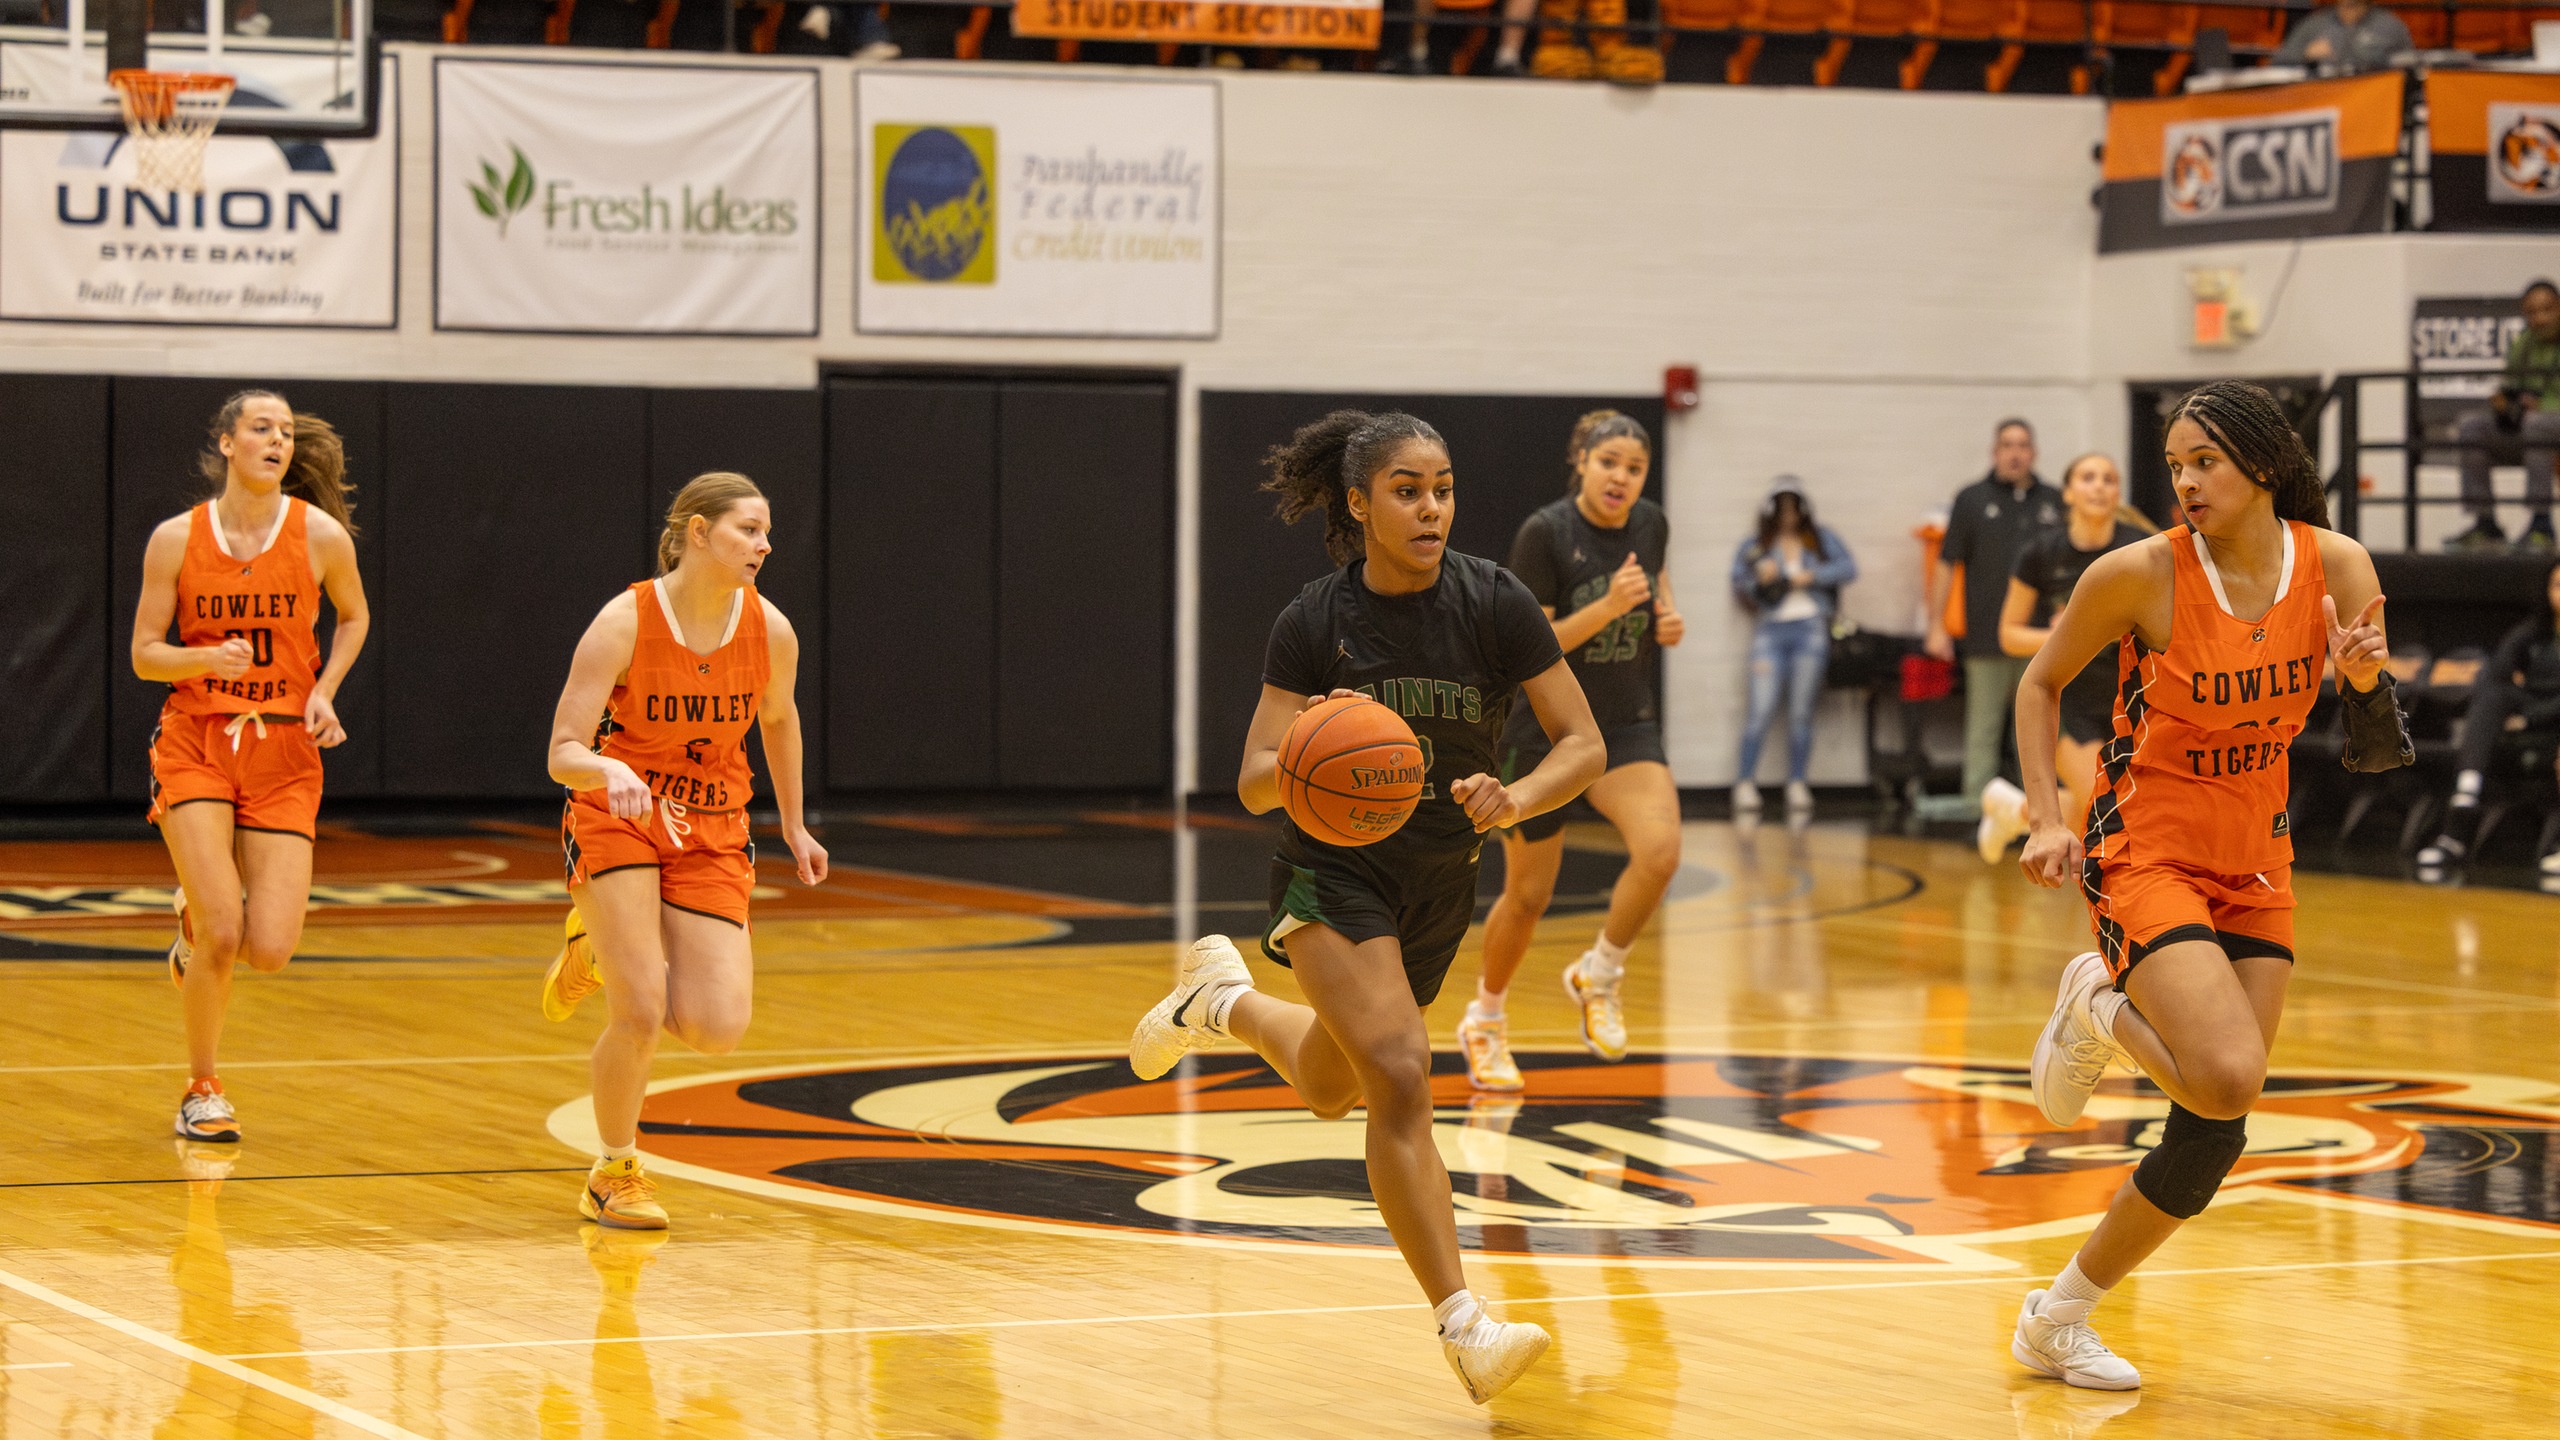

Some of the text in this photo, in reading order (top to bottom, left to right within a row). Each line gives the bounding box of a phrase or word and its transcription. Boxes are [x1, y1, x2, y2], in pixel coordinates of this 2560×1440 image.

[1047, 0, 1367, 36] STUDENT SECTION
[2226, 126, 2328, 199] CSN
[56, 183, 342, 233] UNION
[545, 180, 798, 236] Fresh Ideas
[101, 244, 297, 265] STATE BANK
[171, 286, 234, 308] Better
[2412, 318, 2497, 359] STORE
[196, 593, 297, 619] COWLEY
[203, 678, 288, 701] TIGERS
[2191, 655, 2314, 706] COWLEY
[646, 693, 753, 723] COWLEY
[2186, 741, 2285, 778] TIGERS
[645, 769, 729, 807] TIGERS
